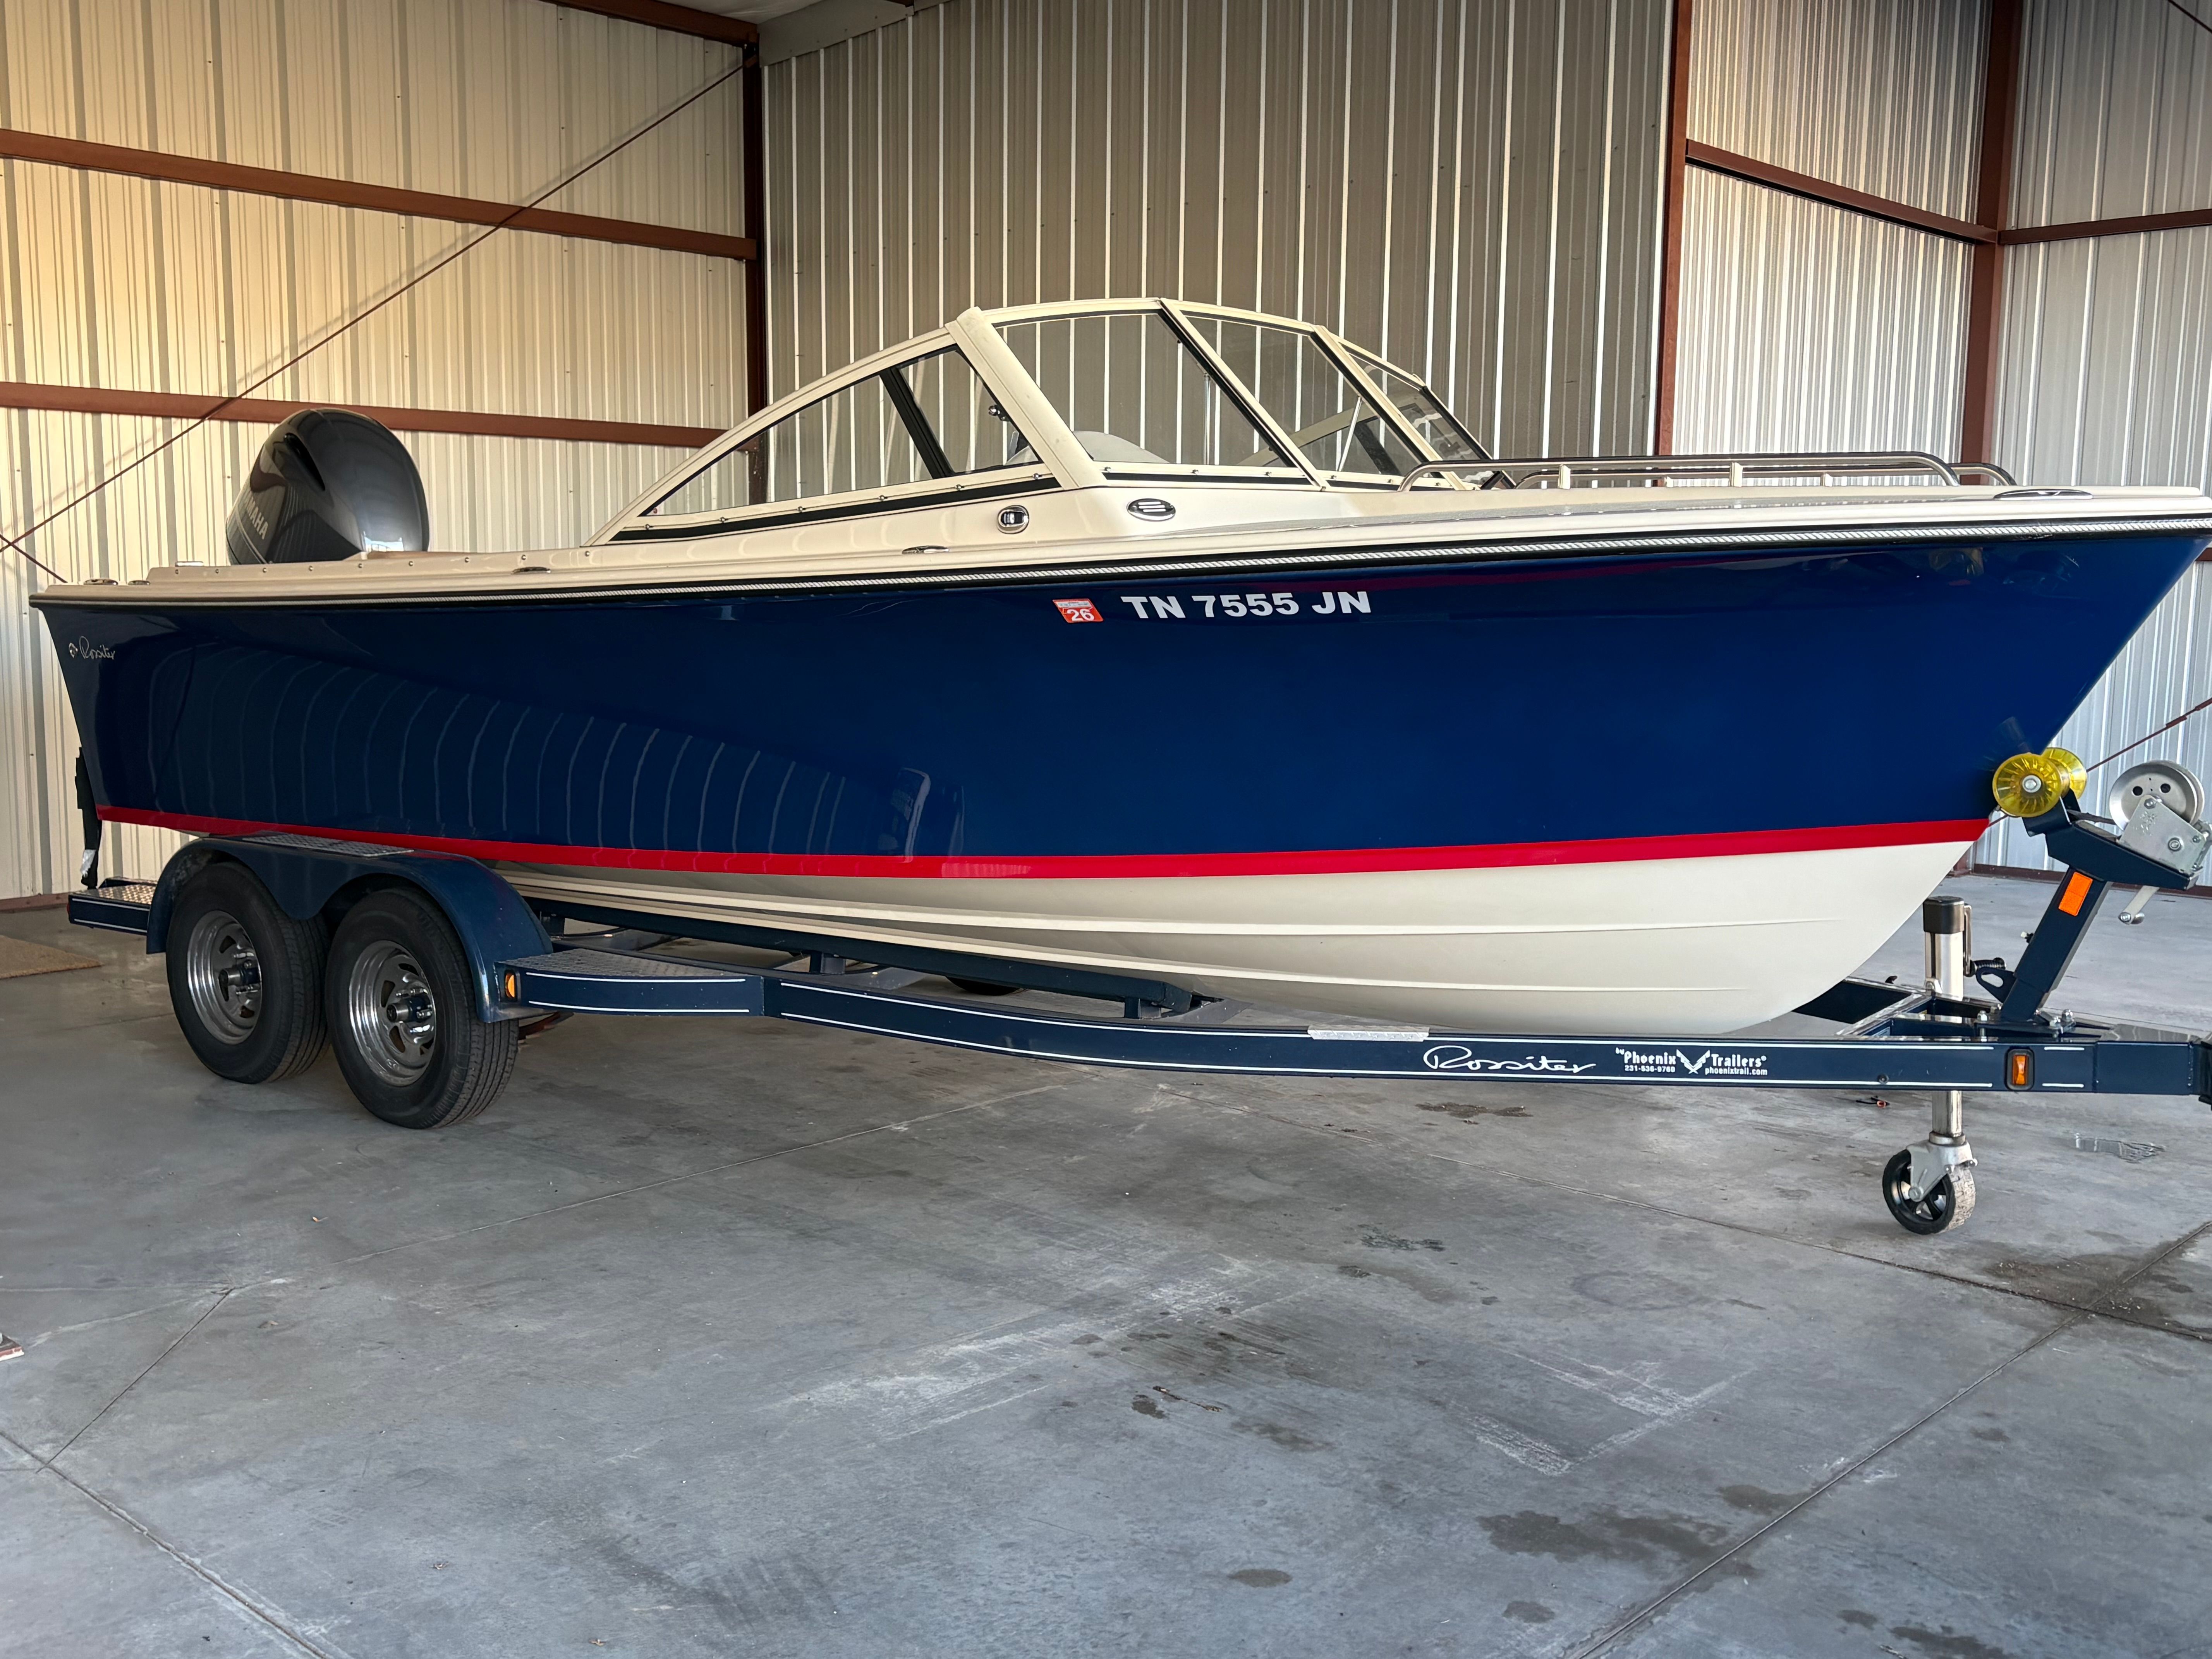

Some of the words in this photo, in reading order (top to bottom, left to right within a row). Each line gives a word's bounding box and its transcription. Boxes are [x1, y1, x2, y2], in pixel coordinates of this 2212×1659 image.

[244, 490, 268, 539] AMAHA
[1120, 596, 1186, 618] TN
[1191, 592, 1299, 617] 7555
[1312, 591, 1371, 614] JN
[1066, 608, 1094, 621] 26
[79, 635, 115, 660] Rossiter
[1423, 1045, 1596, 1073] Rossiter
[1624, 1051, 1676, 1065] Phoenix
[1625, 1065, 1676, 1073] 231-536-9760
[1705, 1066, 1768, 1075] phoenixtrail.com
